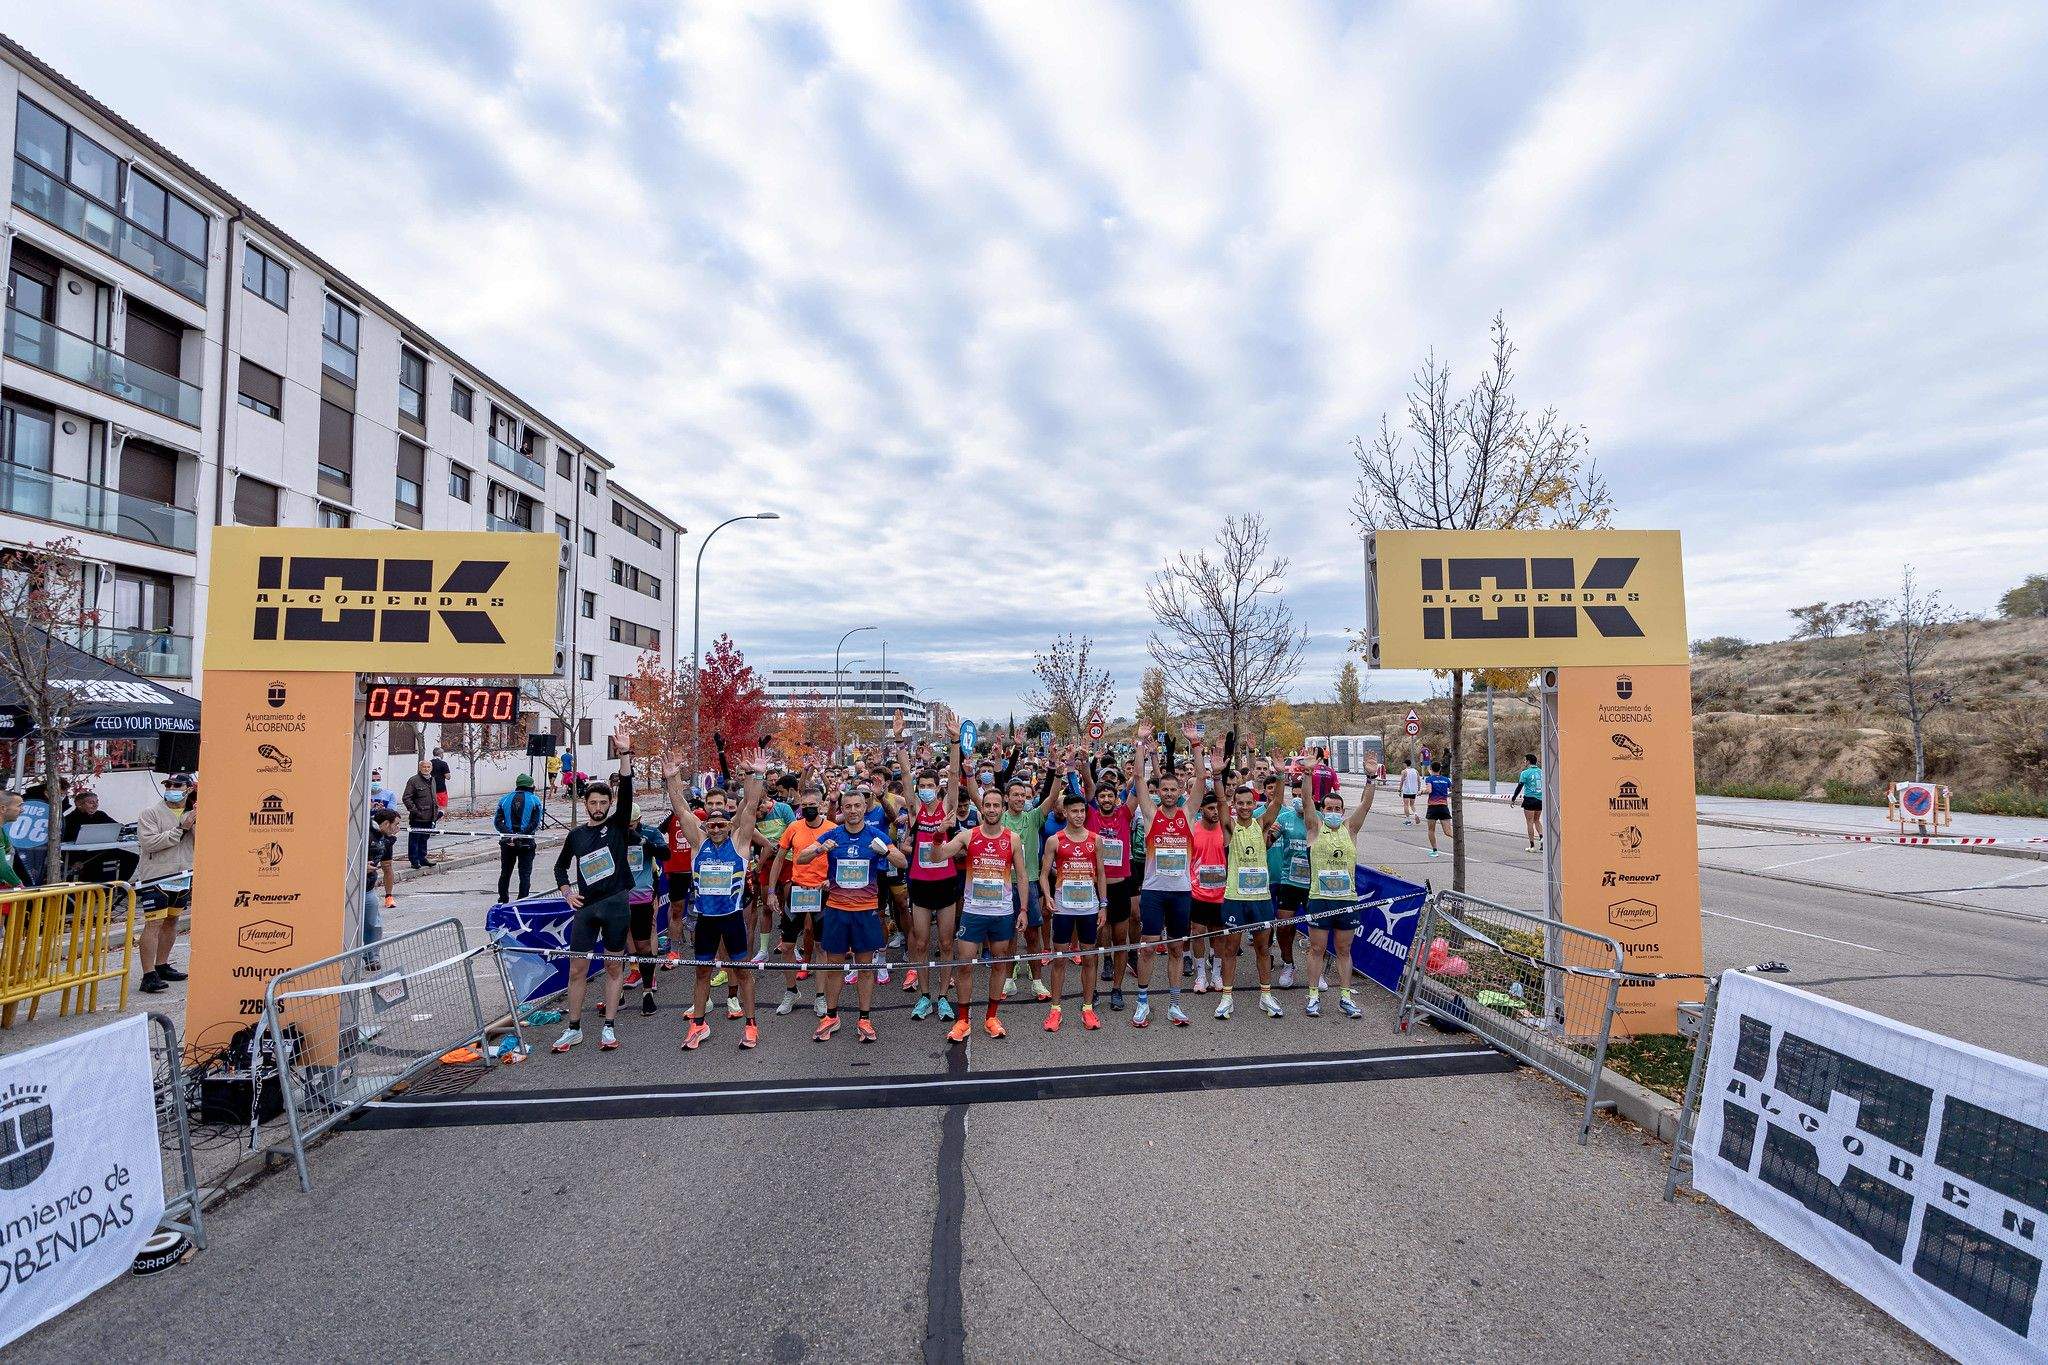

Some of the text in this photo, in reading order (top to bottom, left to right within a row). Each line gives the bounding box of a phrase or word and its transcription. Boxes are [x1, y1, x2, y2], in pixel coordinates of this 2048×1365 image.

[256, 593, 504, 608] ALCOBENDAS
[1422, 592, 1640, 603] ALCOBENDAS
[368, 687, 513, 721] 09:26:00
[1598, 704, 1652, 713] Ayuntamiento de
[94, 716, 194, 731] FEED YOUR DREAMS
[246, 713, 306, 722] Ayuntamiento de
[1598, 713, 1653, 723] ALCOBENDAS
[245, 722, 306, 732] ALCOBENDAS
[1609, 797, 1649, 810] MILENIUM
[249, 812, 294, 825] MILENIUM
[1611, 907, 1655, 918] Hampton
[241, 929, 291, 941] Hampton
[104, 1163, 130, 1192] de
